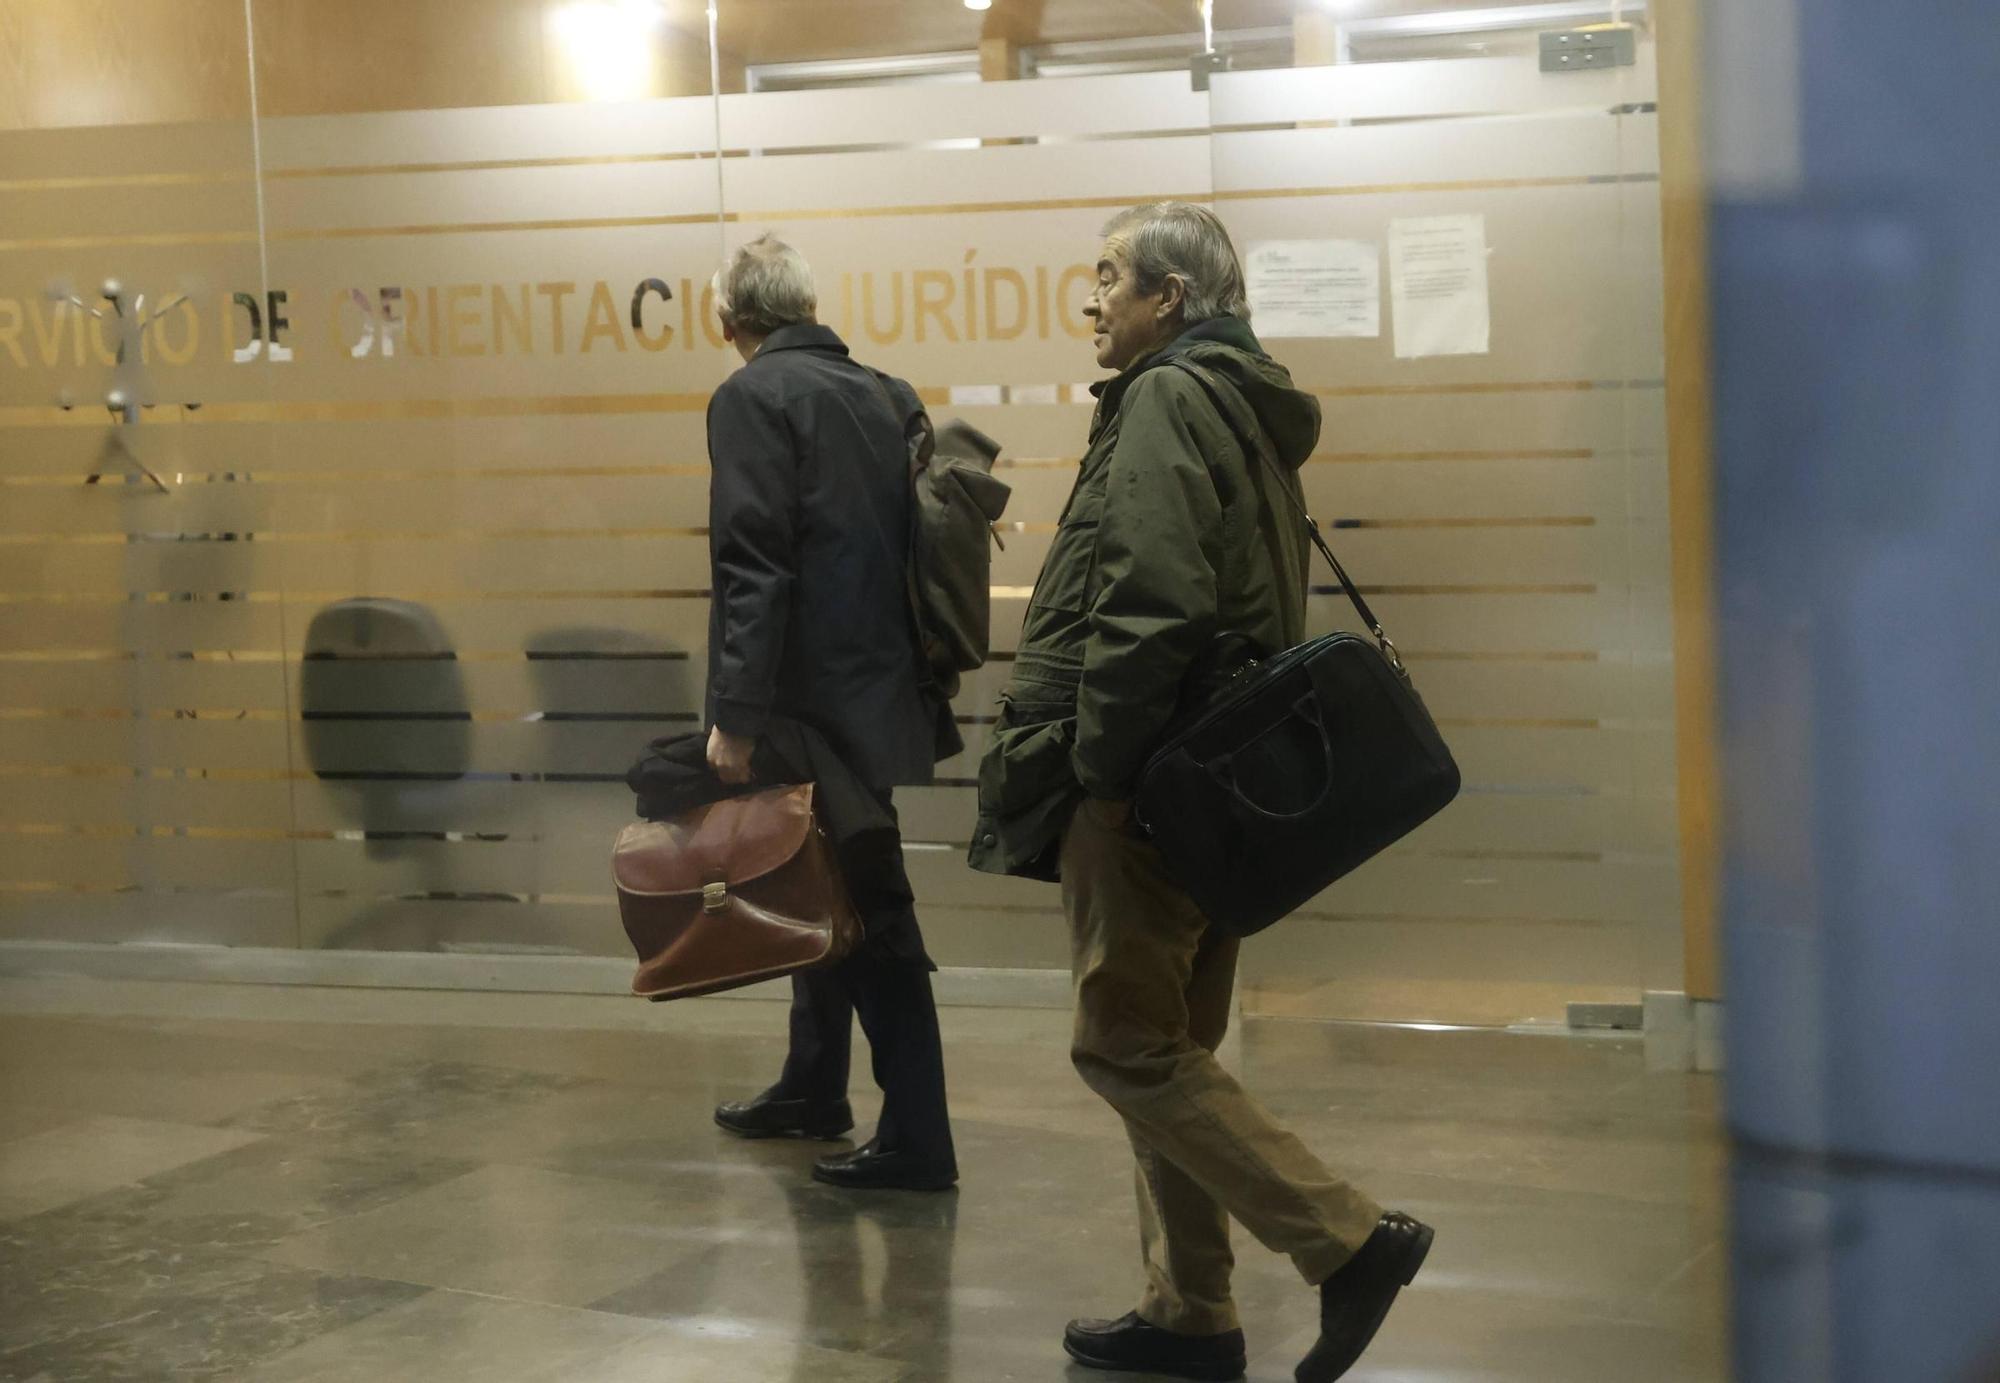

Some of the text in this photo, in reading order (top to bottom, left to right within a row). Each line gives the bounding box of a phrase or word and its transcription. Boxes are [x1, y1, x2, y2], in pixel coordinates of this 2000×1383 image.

[223, 289, 296, 364] DE
[332, 277, 735, 359] ORIENTACI
[837, 248, 1100, 346] JURÍDIC
